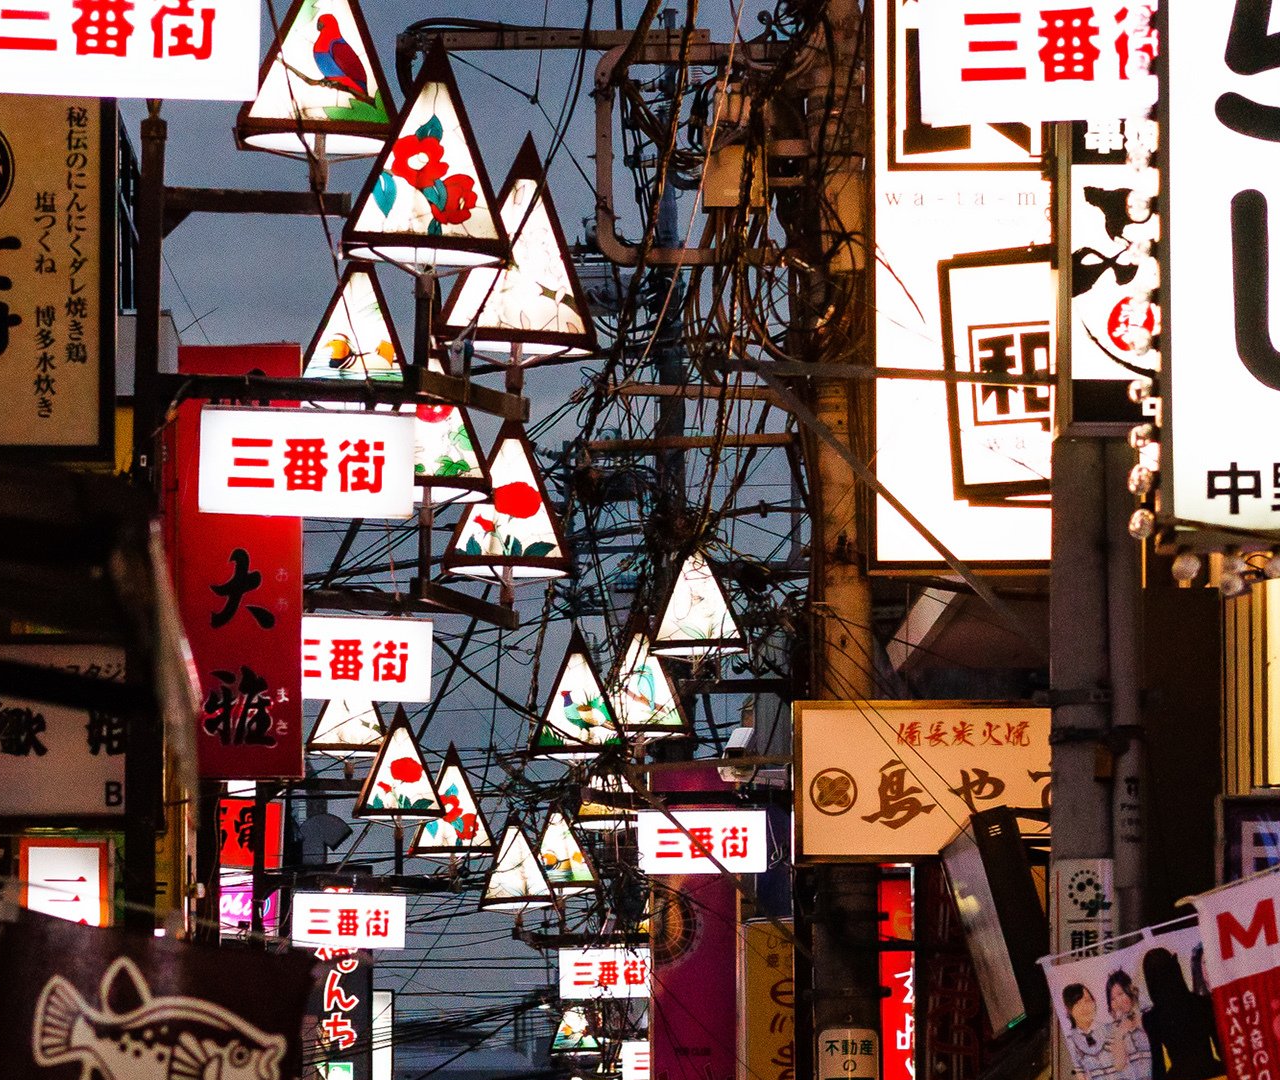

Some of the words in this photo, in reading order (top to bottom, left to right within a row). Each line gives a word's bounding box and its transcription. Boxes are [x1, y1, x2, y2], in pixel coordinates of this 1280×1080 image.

[34, 191, 58, 275] 塩つくね
[65, 105, 90, 365] 秘伝のにんにくダレ焼き鶏
[34, 304, 58, 419] 博多水炊き
[226, 437, 387, 495] 三番街
[654, 826, 750, 860] 三番街
[307, 908, 390, 938] 三番街
[572, 959, 646, 988] 三番街
[825, 1039, 874, 1057] 不動産
[842, 1059, 858, 1072] の
